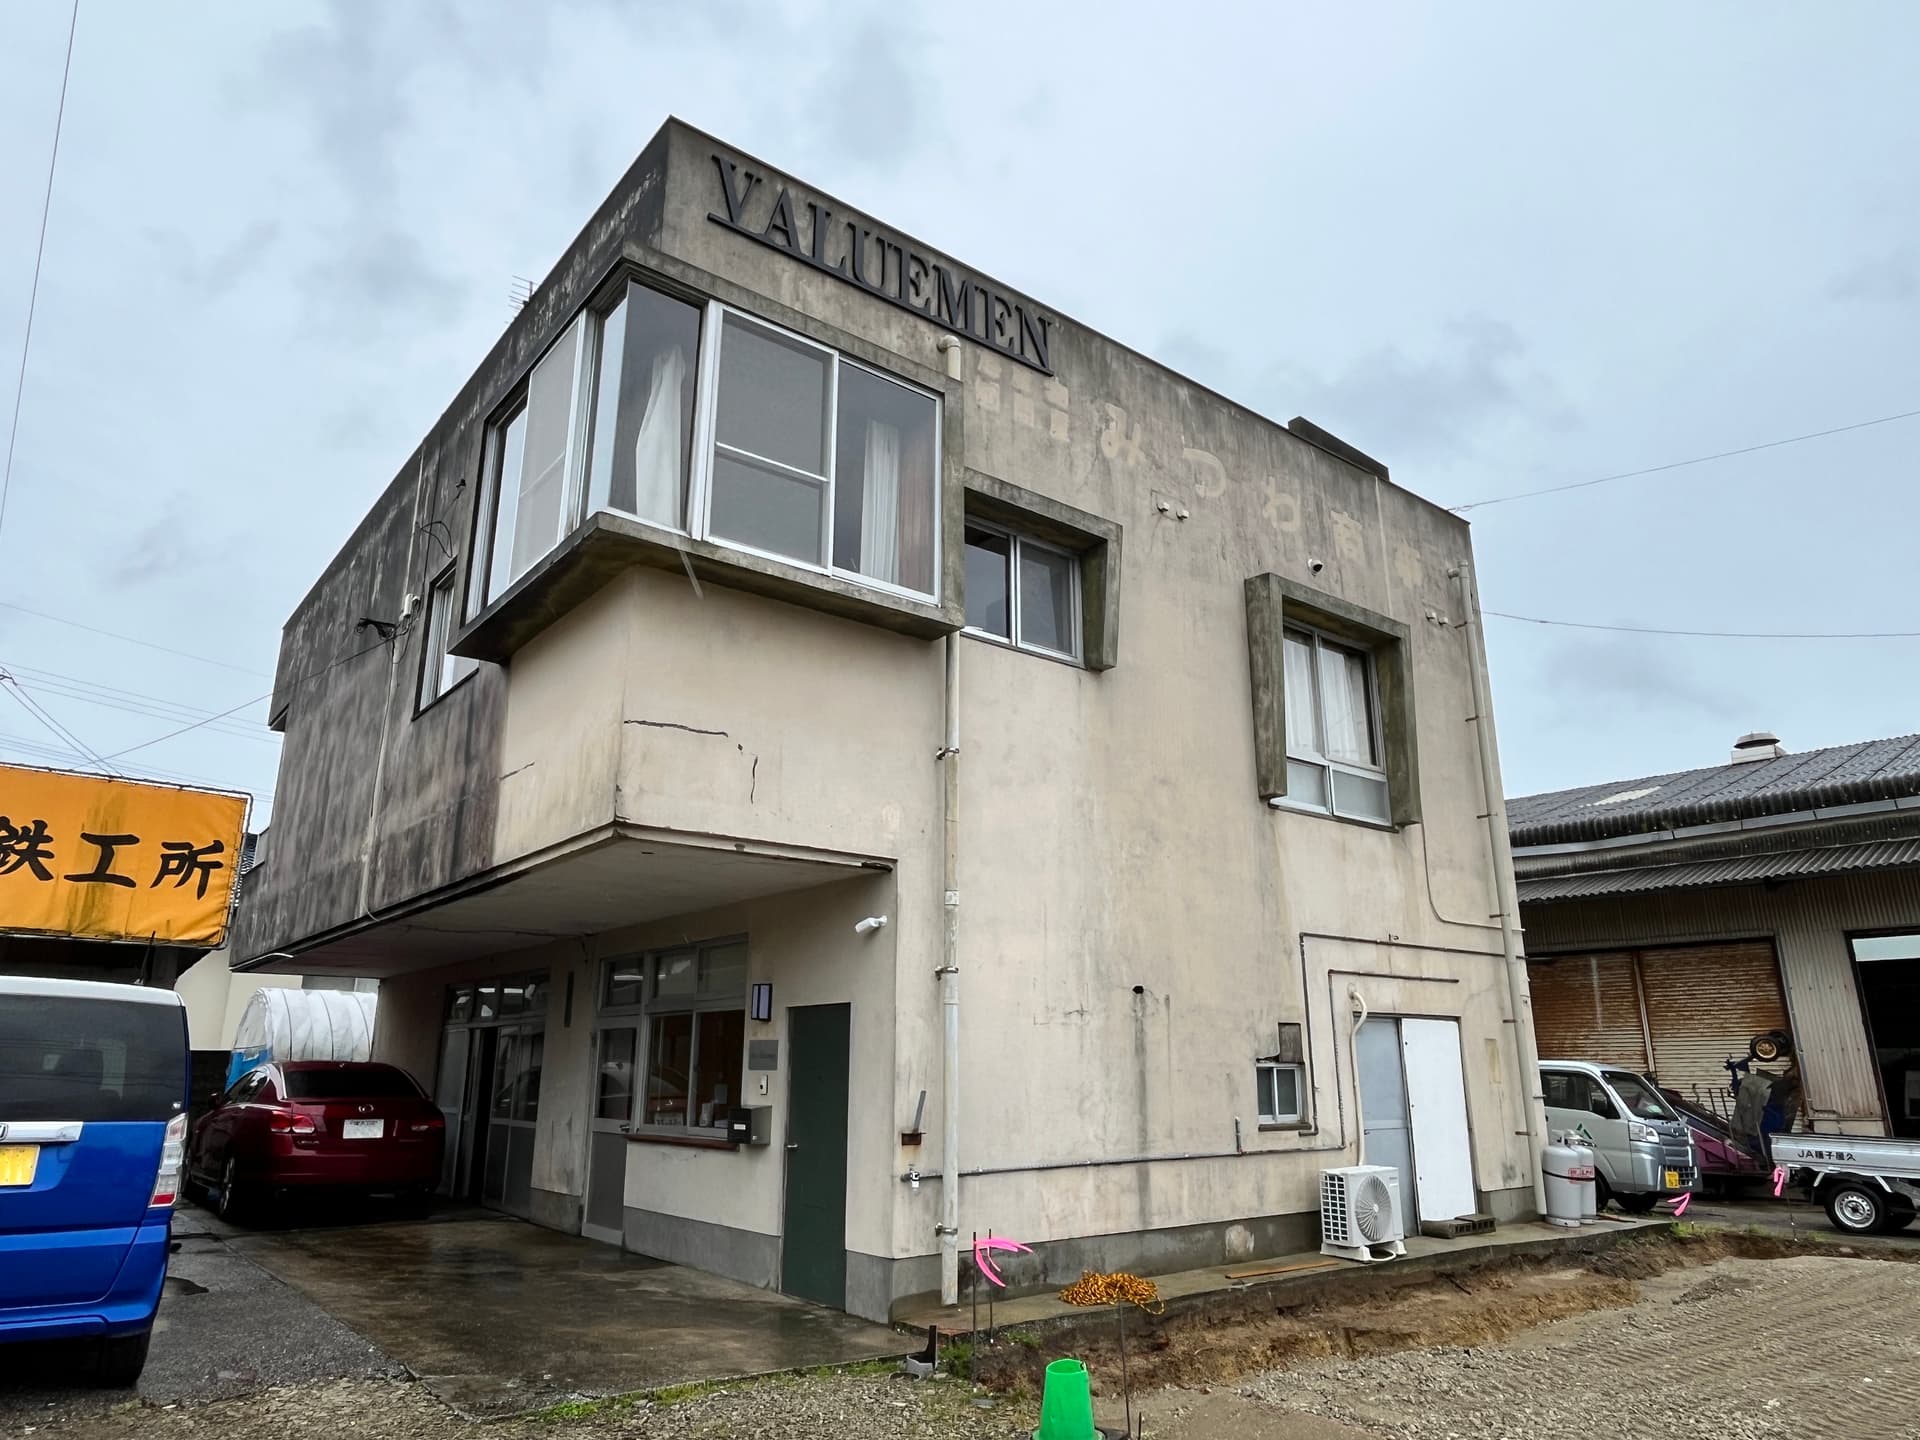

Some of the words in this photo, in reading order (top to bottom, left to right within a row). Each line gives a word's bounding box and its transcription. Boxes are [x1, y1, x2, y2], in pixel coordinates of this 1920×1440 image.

[709, 154, 1053, 372] VALUEMEN
[0, 815, 225, 900] 鉄工所
